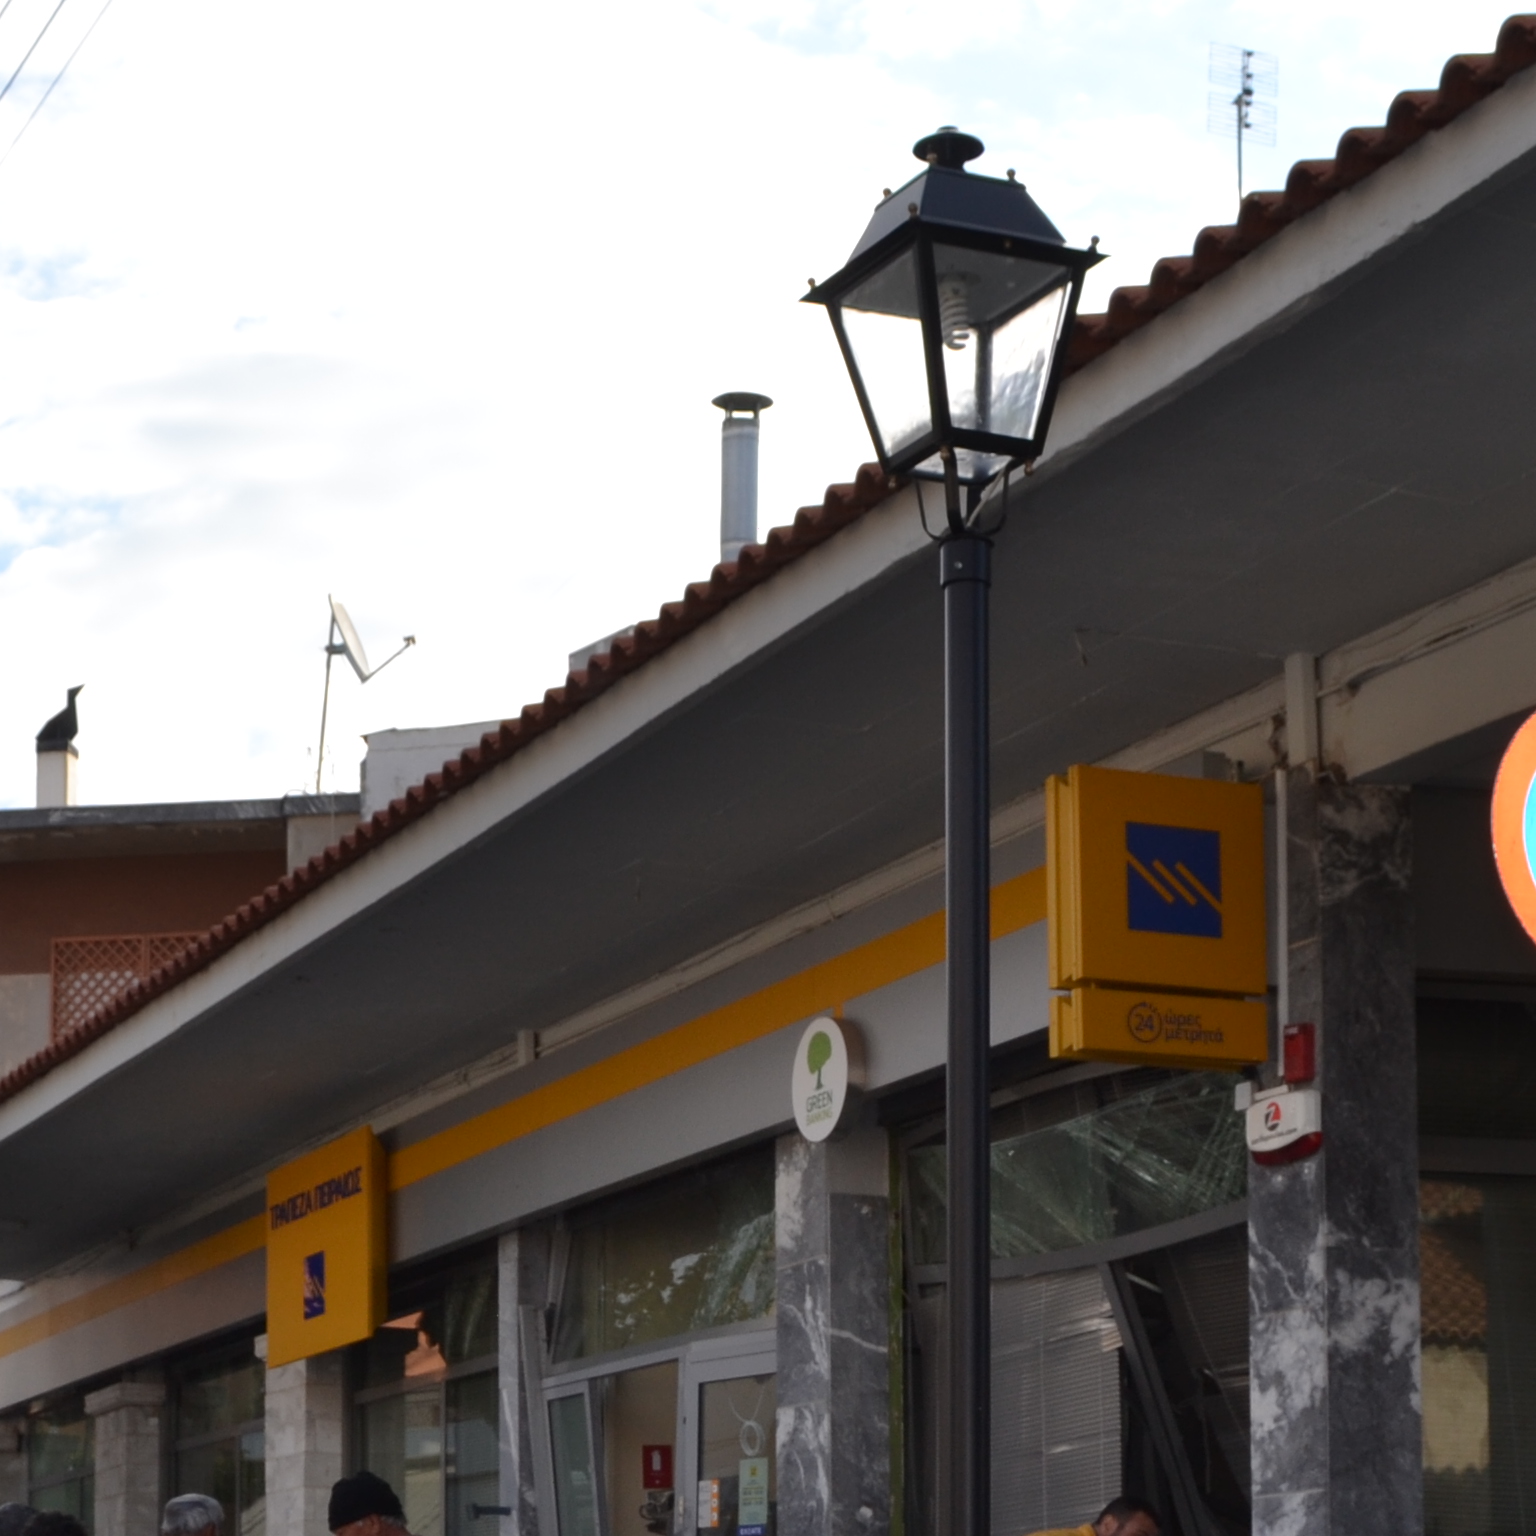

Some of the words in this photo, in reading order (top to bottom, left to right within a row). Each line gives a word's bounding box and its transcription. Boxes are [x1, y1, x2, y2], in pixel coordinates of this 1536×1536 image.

[1135, 1013, 1155, 1032] 24
[1165, 1027, 1225, 1045] μετρητά
[806, 1089, 833, 1113] GREEN
[806, 1109, 833, 1127] BANKING
[269, 1189, 313, 1231] ΤΡΑΠΕΖΑ
